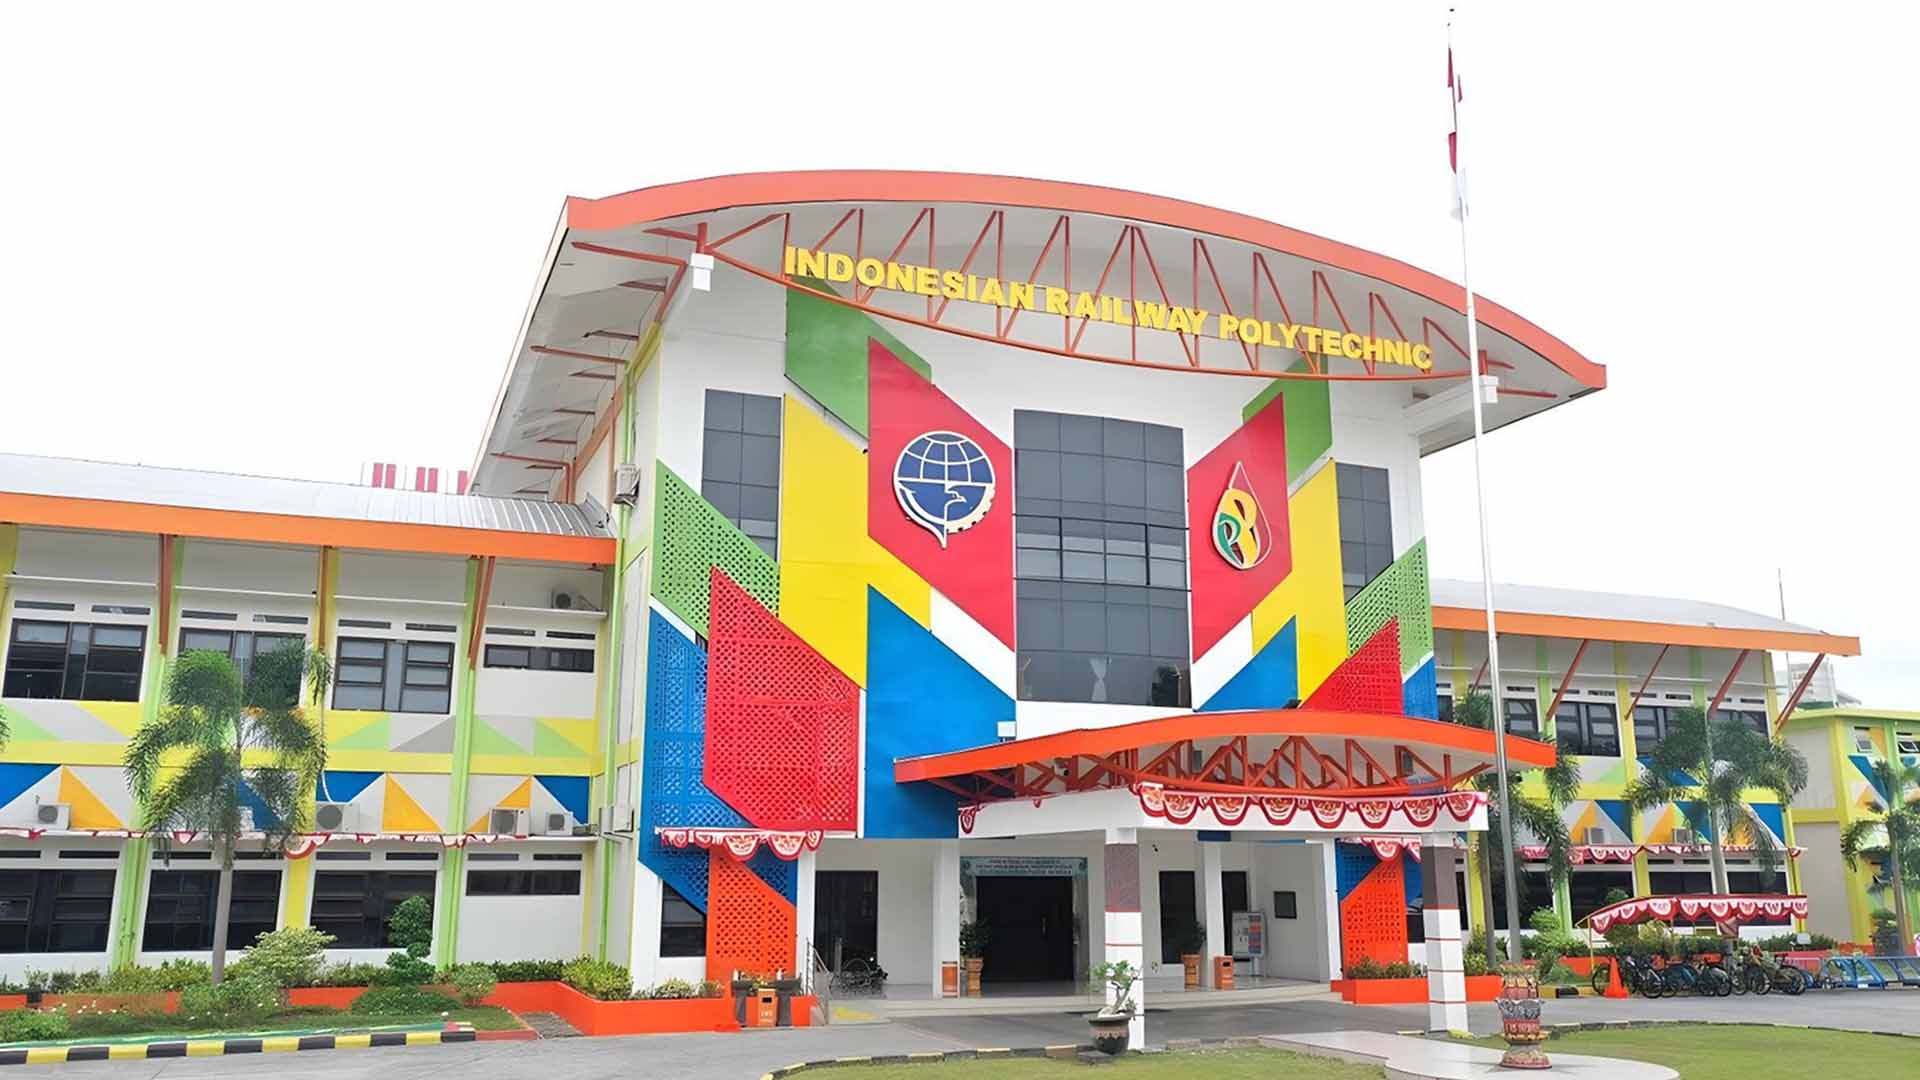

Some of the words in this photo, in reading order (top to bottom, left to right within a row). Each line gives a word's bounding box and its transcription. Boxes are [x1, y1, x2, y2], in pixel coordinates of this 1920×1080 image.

[784, 245, 1035, 310] INDONESIAN
[1046, 287, 1208, 335] RAILWAY
[1219, 313, 1433, 369] POLYTECHNIC
